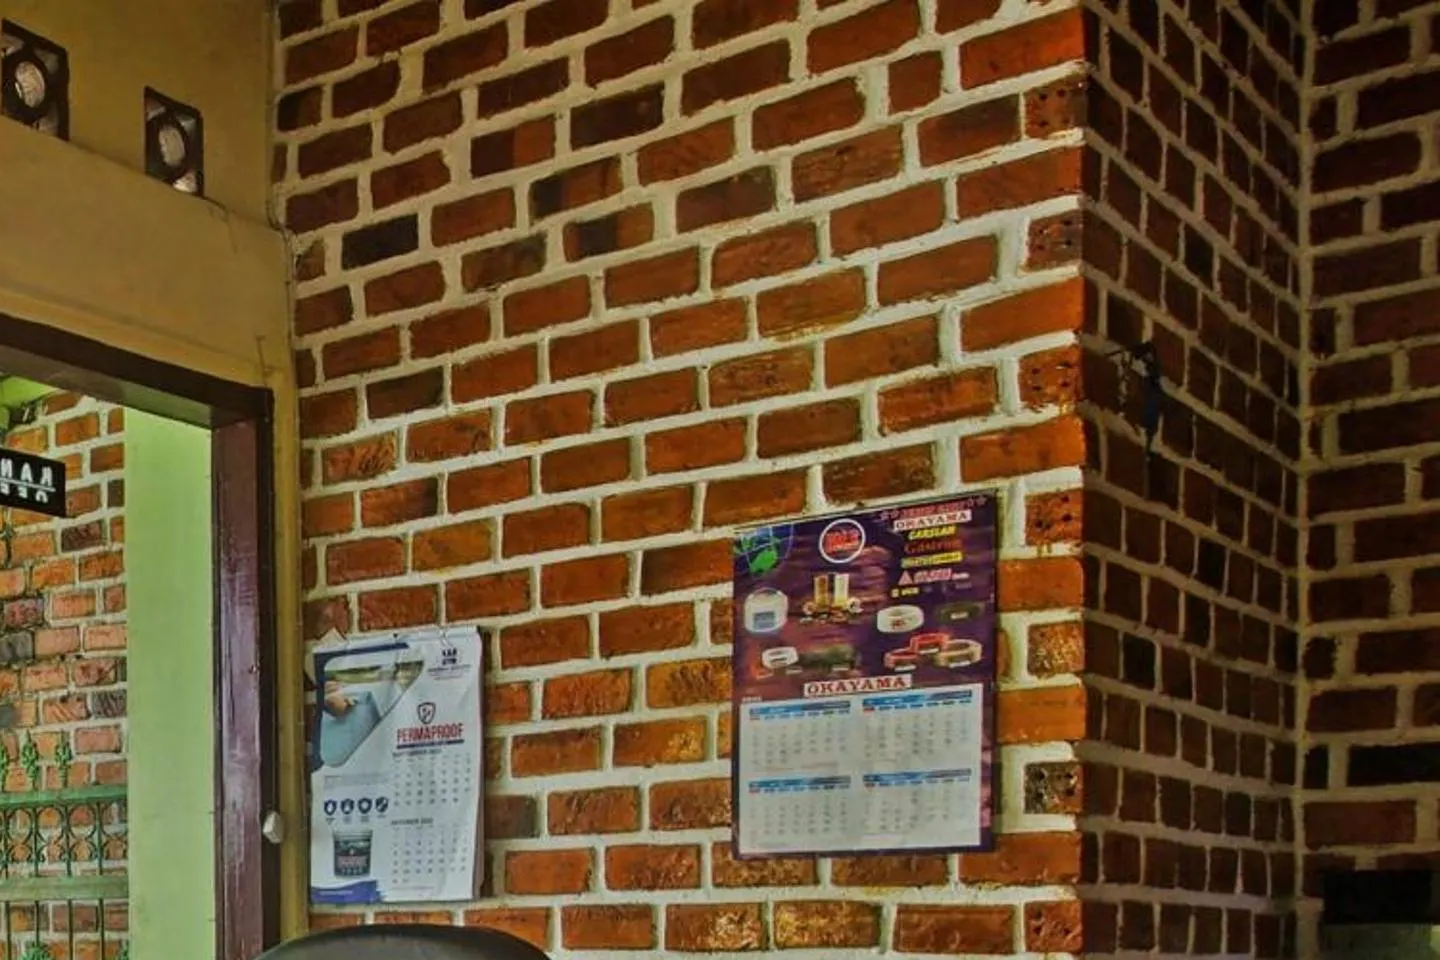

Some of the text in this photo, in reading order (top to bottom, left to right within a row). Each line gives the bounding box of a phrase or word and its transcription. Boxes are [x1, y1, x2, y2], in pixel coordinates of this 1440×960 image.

[896, 511, 967, 529] OKAYAMA
[807, 676, 906, 695] OKAYAMA
[396, 722, 464, 744] PERMAPROOF
